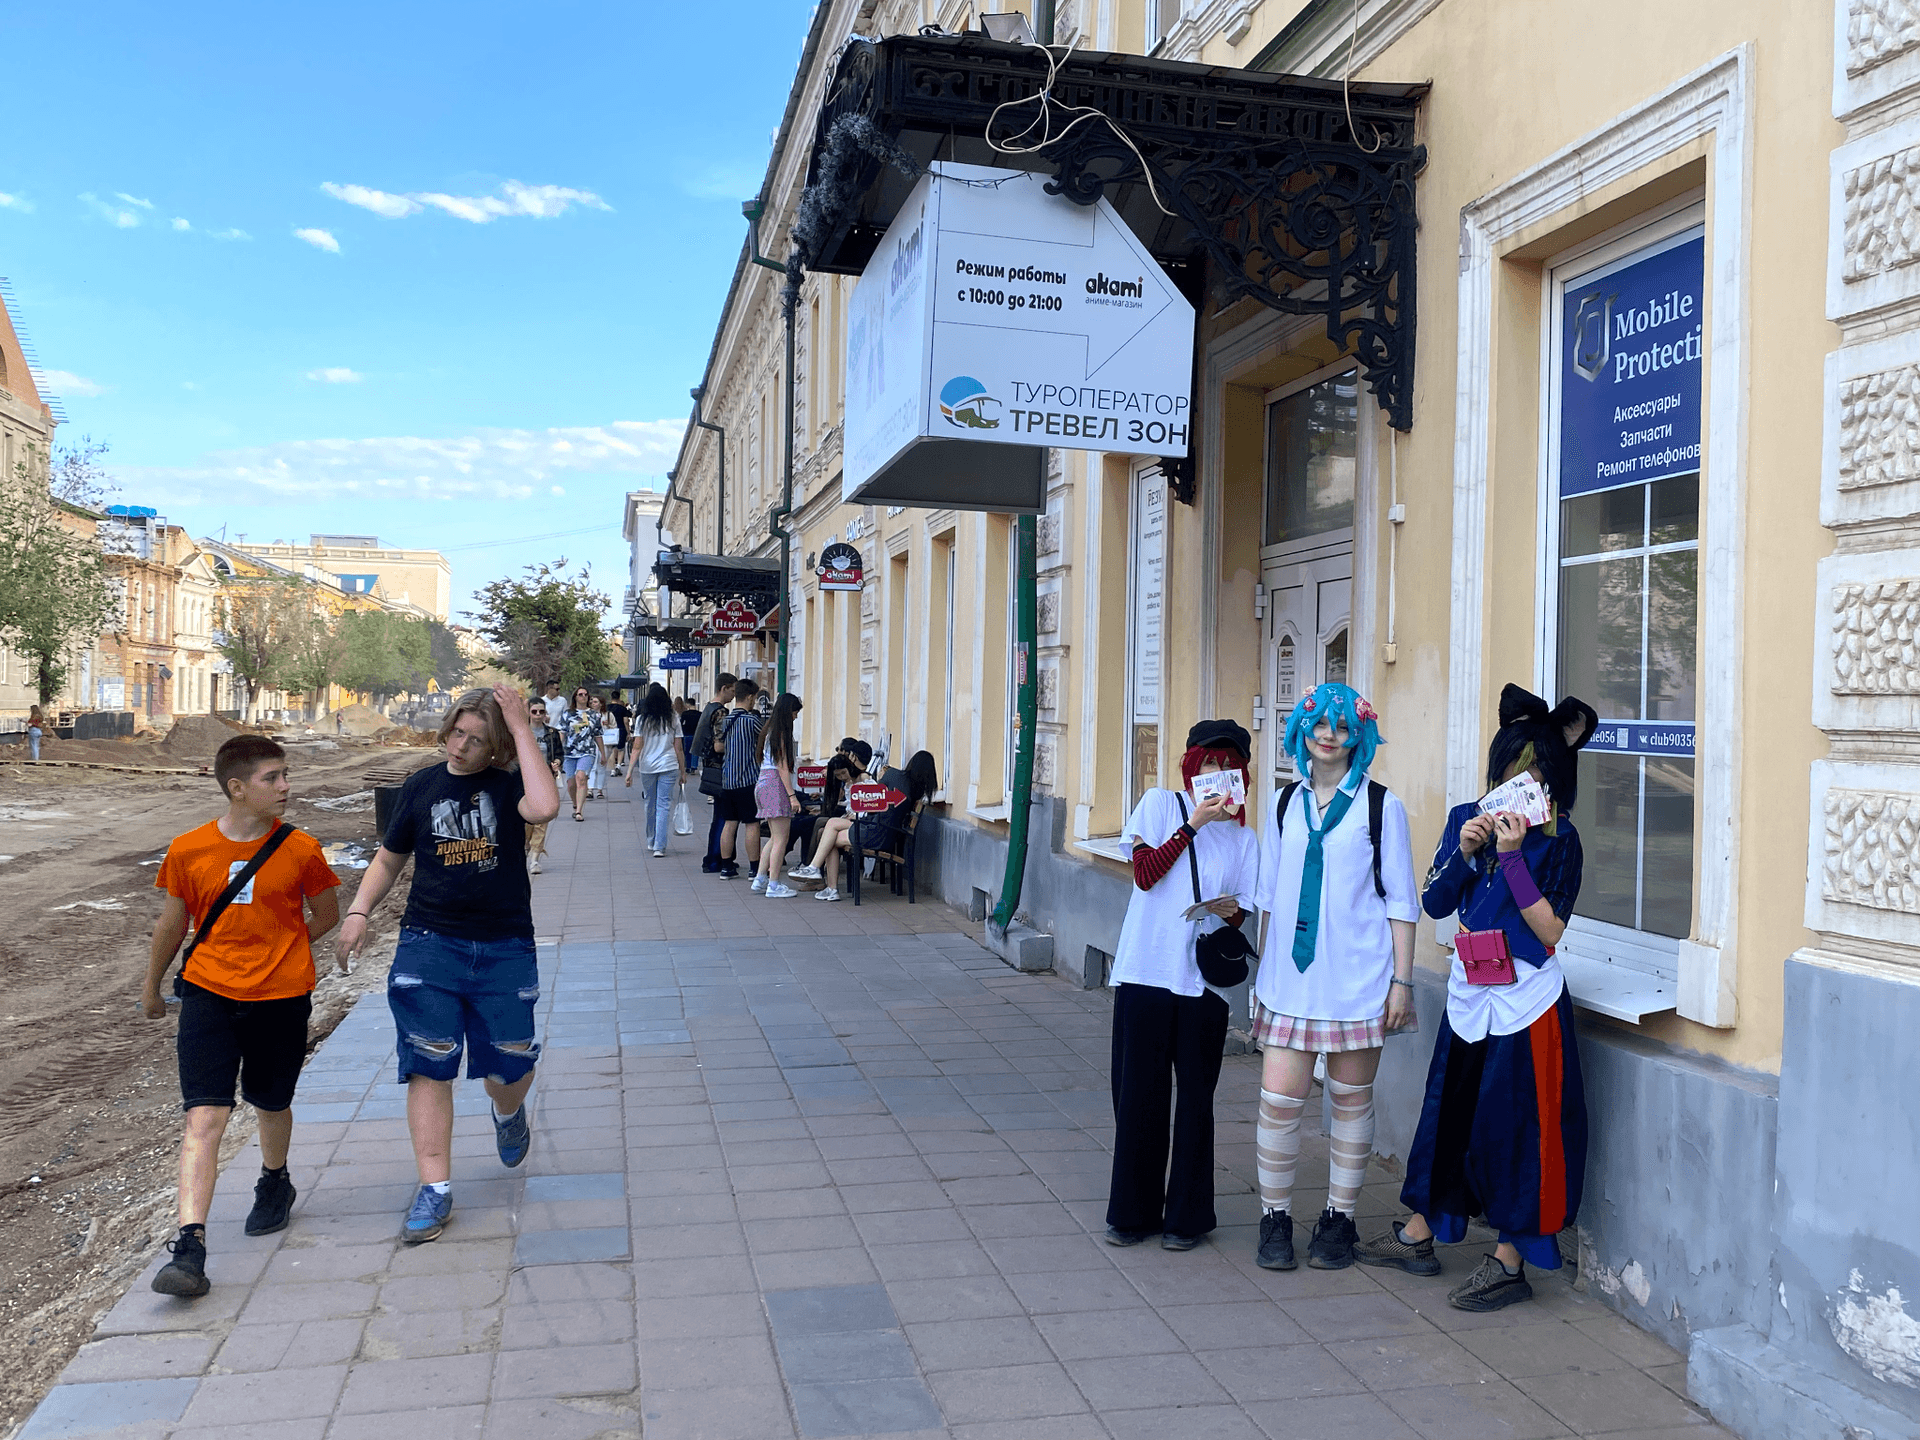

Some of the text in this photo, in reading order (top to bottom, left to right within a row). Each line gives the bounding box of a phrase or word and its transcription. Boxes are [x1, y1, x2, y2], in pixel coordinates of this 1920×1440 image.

[956, 259, 1067, 284] Режим работы
[1086, 272, 1144, 299] akami
[957, 288, 1062, 311] с 10:00 до 21:00
[1085, 297, 1143, 309] аниме-магазин
[1615, 291, 1693, 341] Mobile
[1614, 324, 1702, 384] Protecti
[1011, 381, 1188, 415] ТУРОПЕРАТОР
[1613, 393, 1681, 423] Аксессуары
[1010, 409, 1187, 446] ТРЕВЕЛ ЗОН
[1620, 423, 1672, 448] Запчасти
[1597, 443, 1701, 478] Ремонт телефонов
[851, 789, 886, 800] akami
[436, 837, 487, 856] RUNNING
[444, 846, 494, 866] DISTRICT
